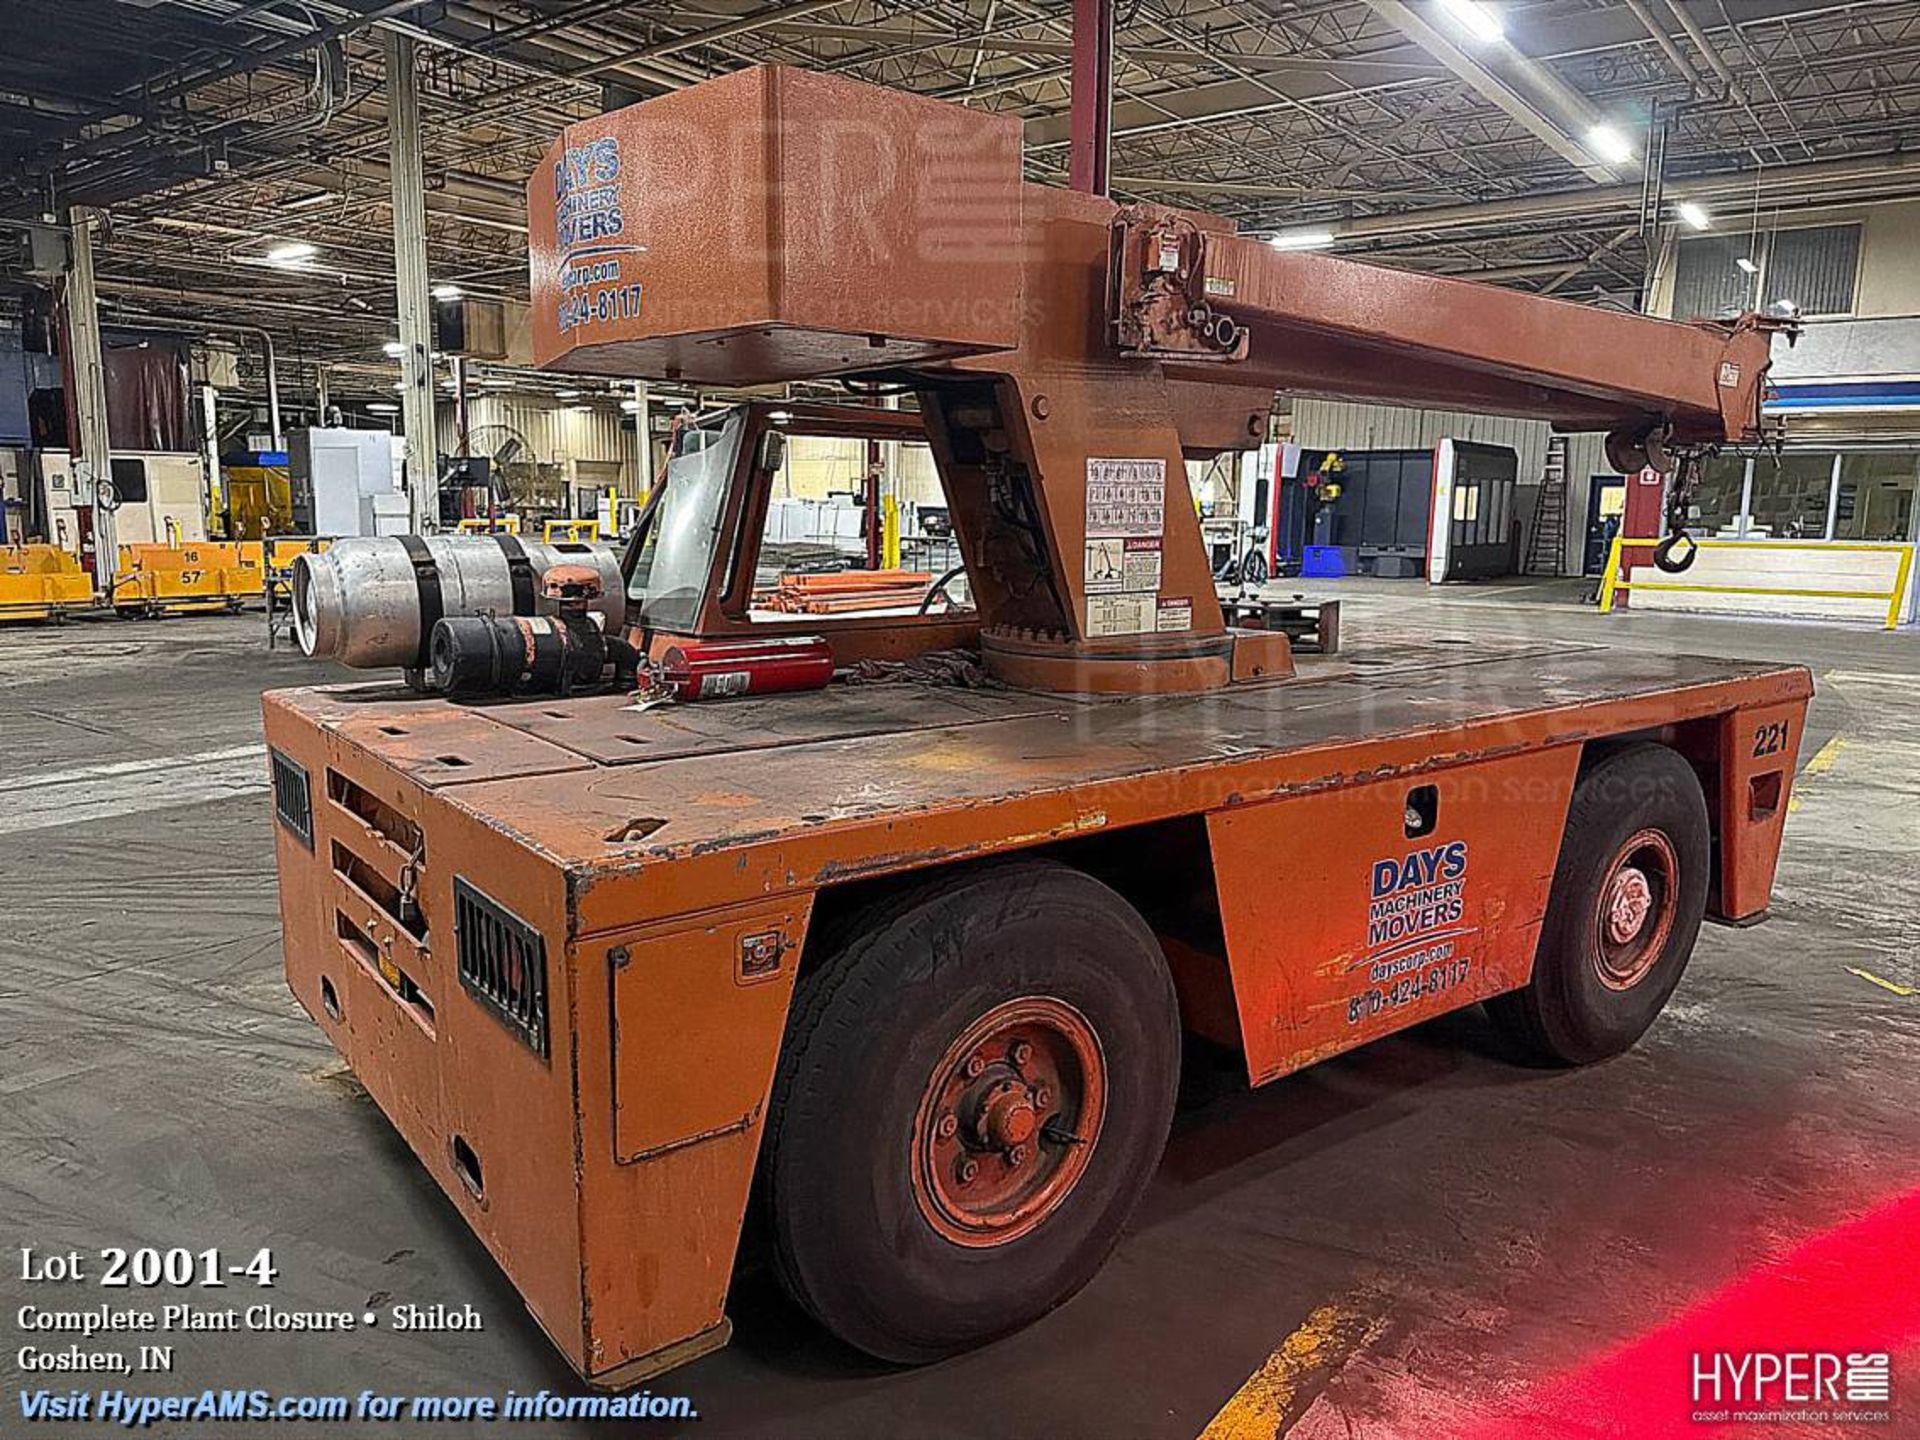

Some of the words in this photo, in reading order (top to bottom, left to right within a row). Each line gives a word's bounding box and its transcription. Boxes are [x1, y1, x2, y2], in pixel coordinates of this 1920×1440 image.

[184, 551, 199, 562] 16
[181, 571, 201, 584] 57
[1752, 719, 1789, 758] 221
[1371, 841, 1468, 898] DAYS
[1370, 879, 1466, 921] MACHINERY
[1368, 898, 1464, 947] MOVERS
[1371, 942, 1455, 983] dayscorp.com
